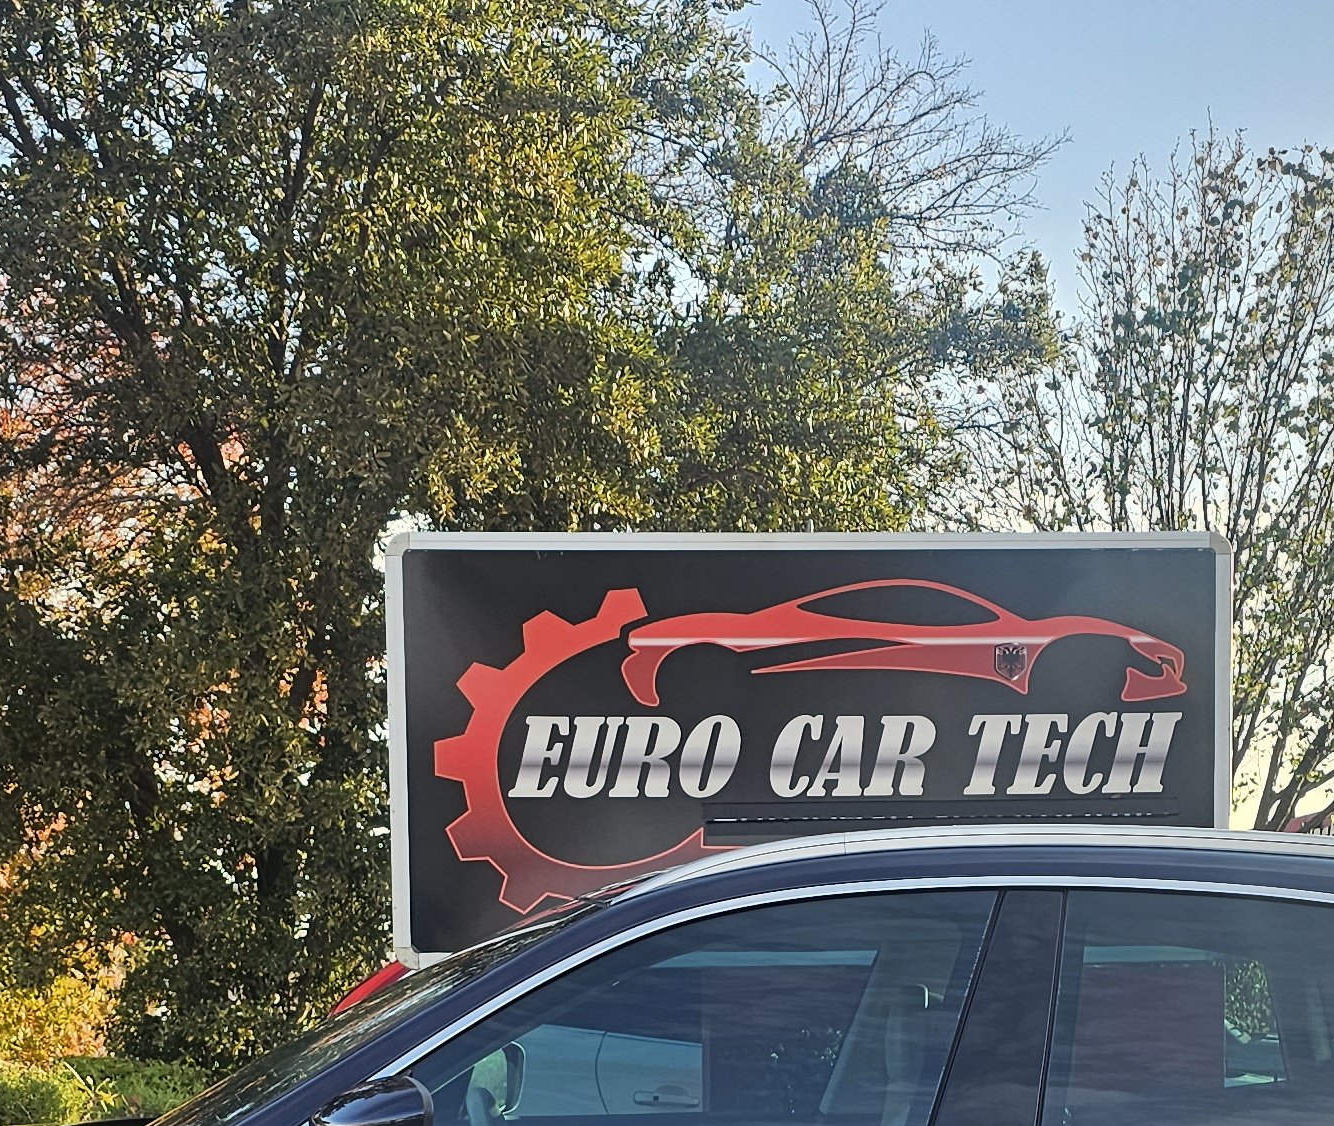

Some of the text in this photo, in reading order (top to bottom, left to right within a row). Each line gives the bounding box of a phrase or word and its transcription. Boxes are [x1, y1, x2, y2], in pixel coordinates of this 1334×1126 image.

[508, 711, 1183, 799] EURO CAR TECH
